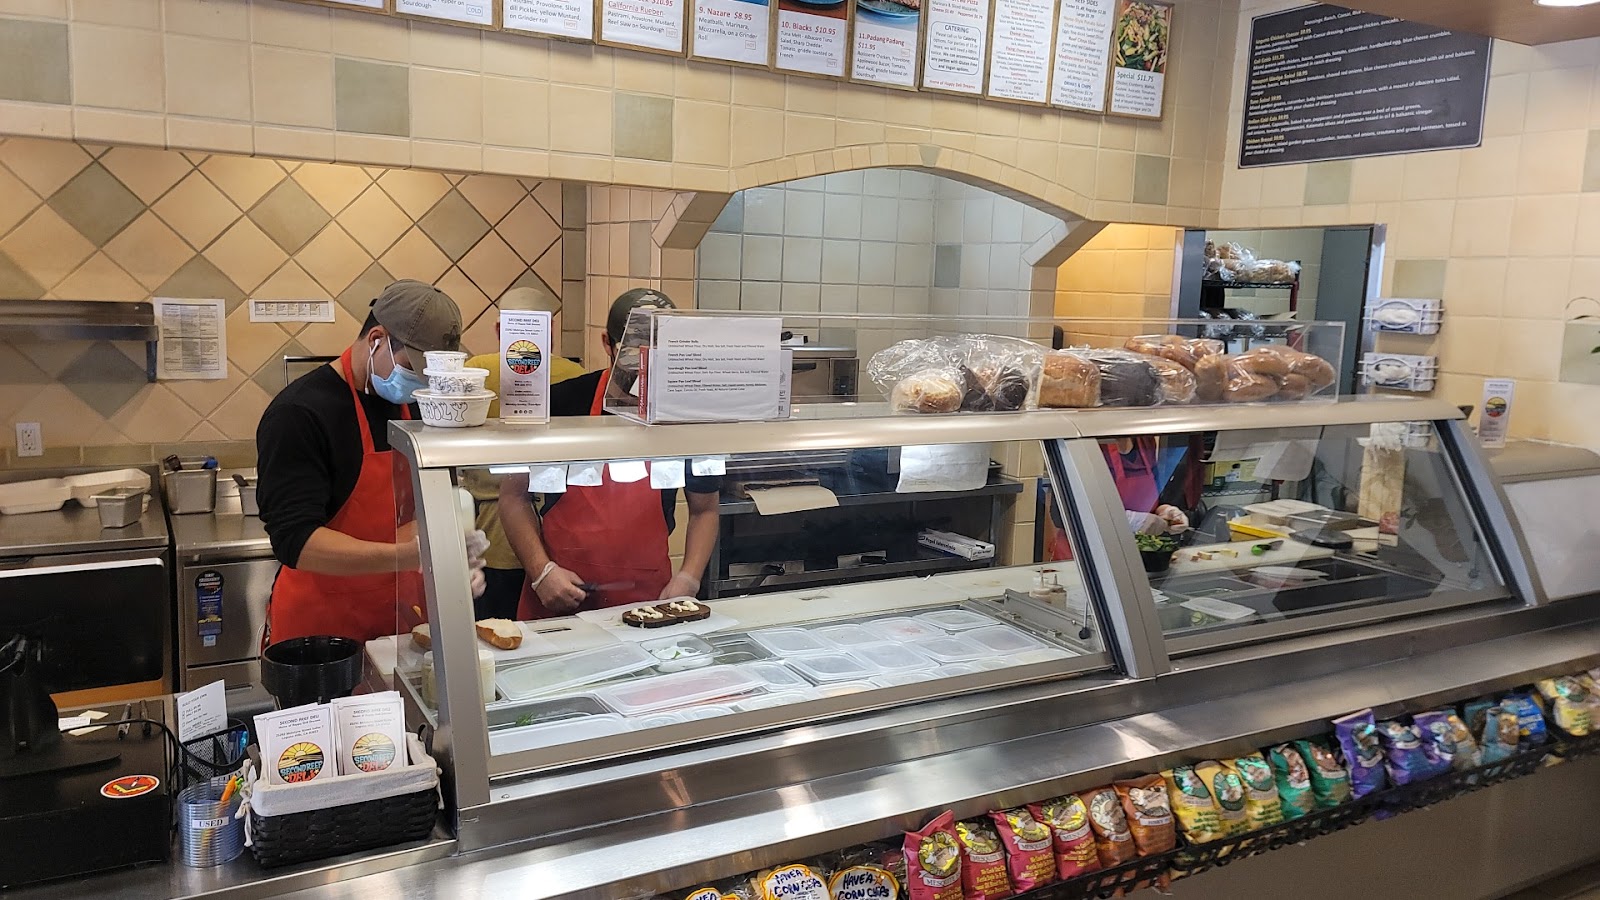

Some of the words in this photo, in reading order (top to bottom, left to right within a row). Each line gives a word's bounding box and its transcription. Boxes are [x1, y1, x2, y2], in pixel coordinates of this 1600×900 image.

[467, 6, 483, 14] COLD
[608, 0, 639, 12] California
[518, 14, 538, 22] Grinder
[519, 6, 538, 14] Pickles,
[558, 12, 582, 21] Mustard,
[608, 11, 630, 20] Pastrami,
[655, 19, 676, 27] Mustard,
[698, 6, 706, 14] 9.
[707, 8, 731, 18] Nazare
[734, 11, 752, 21] $8.95
[640, 24, 665, 33] Sourdough
[698, 17, 724, 27] Meatballs,
[725, 21, 750, 30] Marinara,
[782, 21, 791, 29] 10.
[792, 22, 813, 31] Blacks
[815, 26, 836, 35] $10.95
[944, 24, 970, 33] CATERING
[698, 25, 727, 36] Mozzarella,
[738, 31, 758, 39] Grinder
[886, 38, 905, 47] Padang
[1117, 72, 1135, 81] Special
[1137, 74, 1154, 82] $11.75
[508, 358, 528, 366] SECOND
[514, 364, 535, 374] DELI
[279, 718, 298, 726] SECOND
[354, 753, 380, 764] SECOND
[280, 763, 306, 777] SECOND
[306, 760, 323, 770] REEF
[288, 769, 316, 783] DELI
[199, 819, 224, 828] USED
[1022, 841, 1046, 850] MESQUITE
[842, 871, 873, 890] HAVE'A
[774, 883, 800, 897] CORN
[837, 888, 866, 900] CORN
